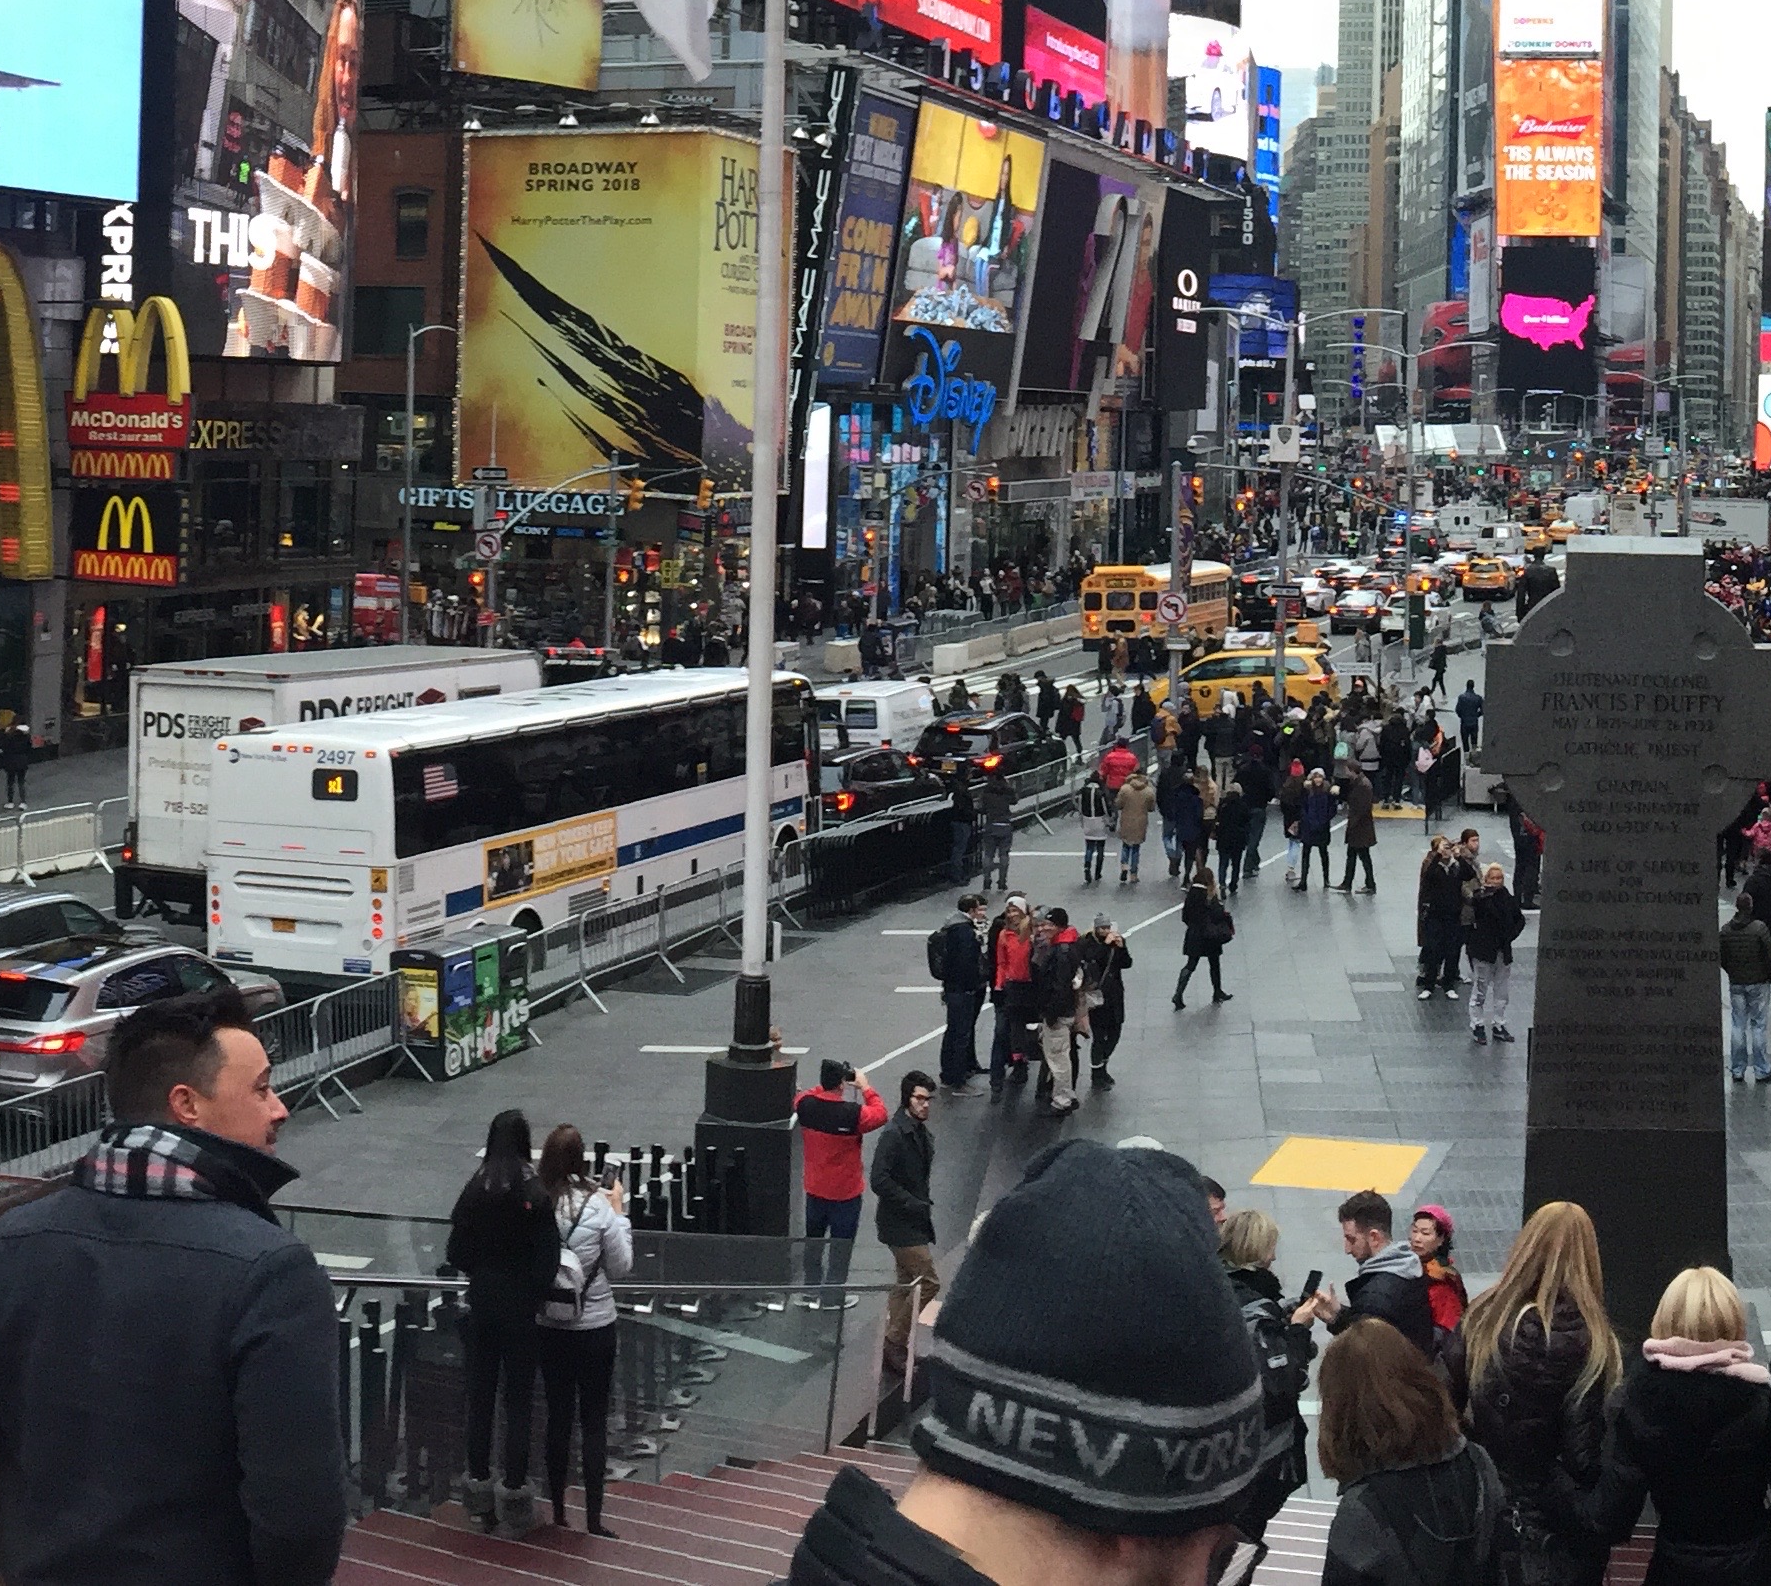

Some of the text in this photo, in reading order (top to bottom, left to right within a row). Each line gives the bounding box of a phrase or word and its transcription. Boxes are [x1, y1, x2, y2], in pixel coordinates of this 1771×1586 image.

[1519, 119, 1586, 133] Budweiser
[529, 162, 638, 175] BROADWAY
[1504, 165, 1596, 180] THE SEASON
[526, 180, 640, 192] SPRING 2018
[511, 216, 652, 227] HarryPotterThePlay.com
[1243, 196, 1253, 244] 1500
[188, 208, 276, 270] THIS
[71, 411, 183, 428] McDonald's
[89, 431, 163, 443] Restaurant
[399, 488, 625, 515] GIFTS LUGGAGE
[1541, 692, 1725, 712] FRANCIS DUFFY
[143, 711, 184, 738] PDS
[317, 750, 354, 764] 2497
